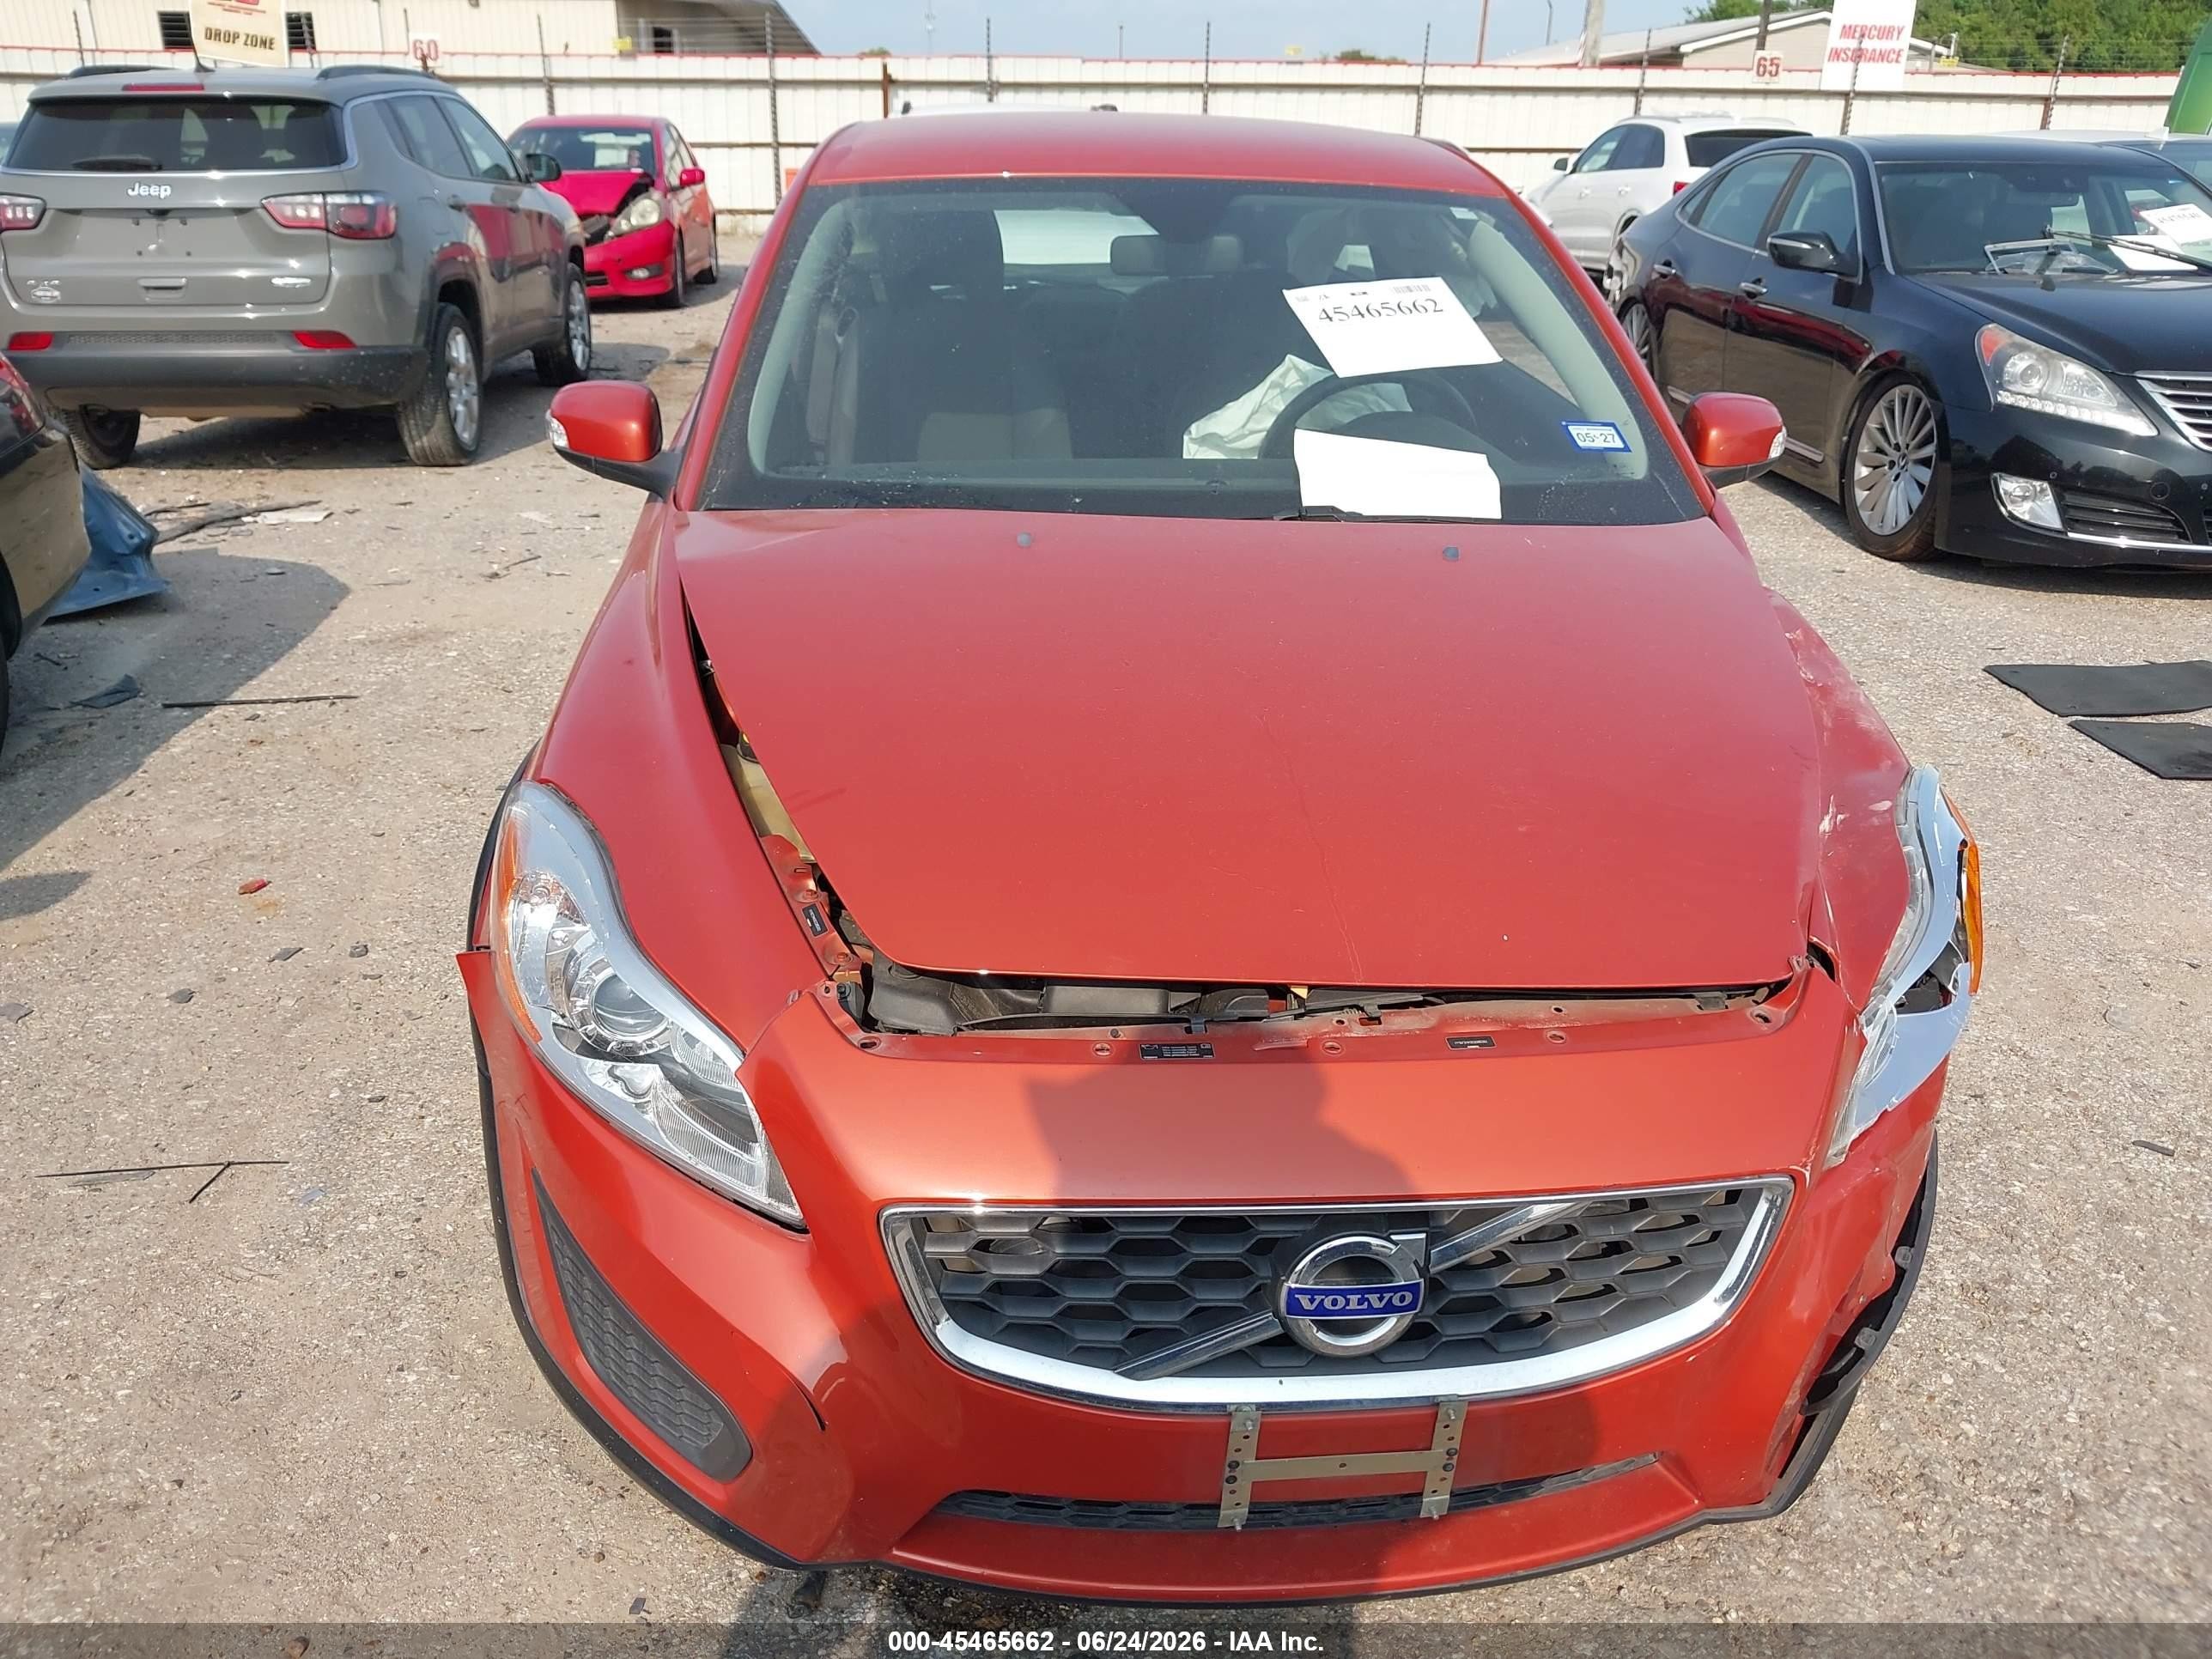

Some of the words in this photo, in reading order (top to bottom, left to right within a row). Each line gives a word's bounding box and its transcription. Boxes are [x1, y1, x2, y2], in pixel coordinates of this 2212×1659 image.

[204, 27, 240, 45] DROP
[243, 33, 276, 51] ZONE
[1839, 23, 1905, 41] MERCURY
[413, 39, 439, 61] 60
[1756, 56, 1781, 77] 65
[127, 182, 172, 199] Jeep
[1318, 298, 1443, 322] 45465662
[1294, 1291, 1413, 1310] VOLVO
